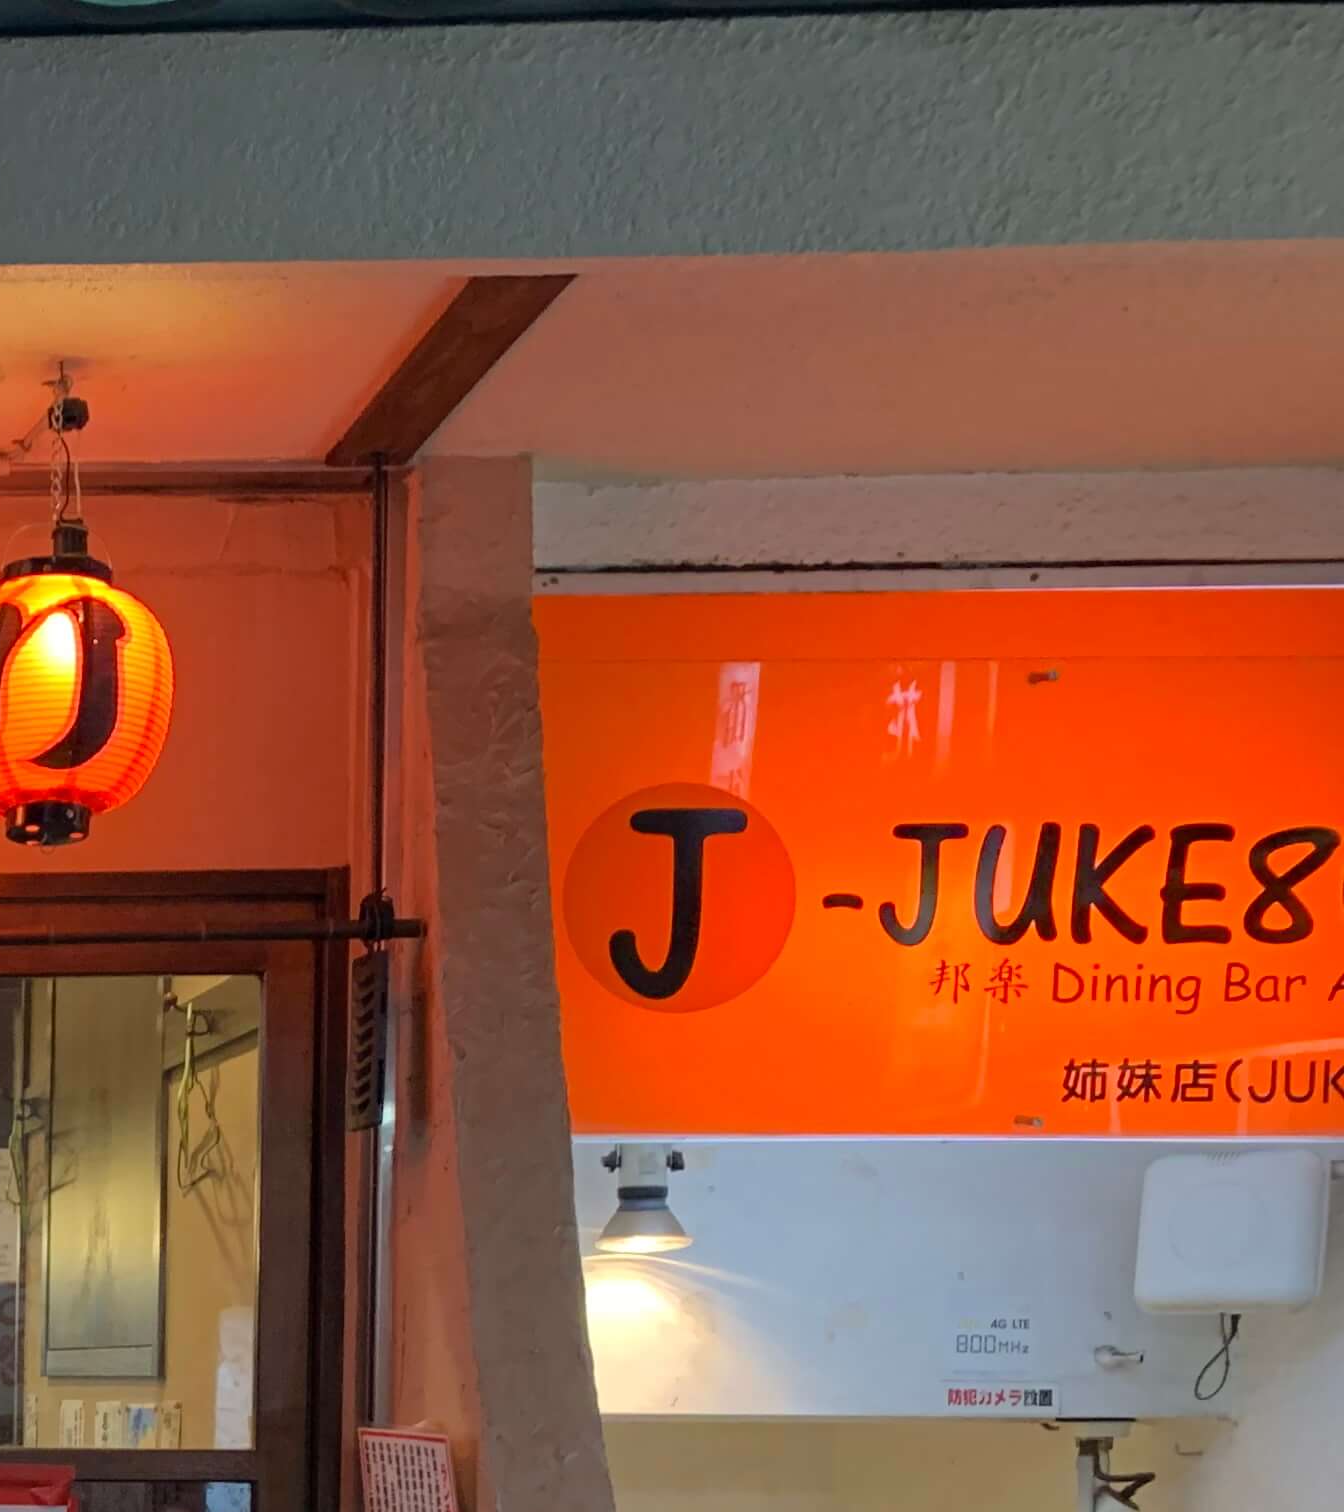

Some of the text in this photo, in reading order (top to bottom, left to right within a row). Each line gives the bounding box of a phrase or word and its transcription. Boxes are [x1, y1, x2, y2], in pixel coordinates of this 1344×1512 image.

[608, 807, 747, 1000] J
[929, 958, 1029, 1007] 邦楽
[1053, 962, 1201, 1015] Dining
[1224, 962, 1307, 1005] Bar
[990, 1319, 1030, 1329] 4G LTE
[948, 1388, 1052, 1406] 防犯カメラ設置
